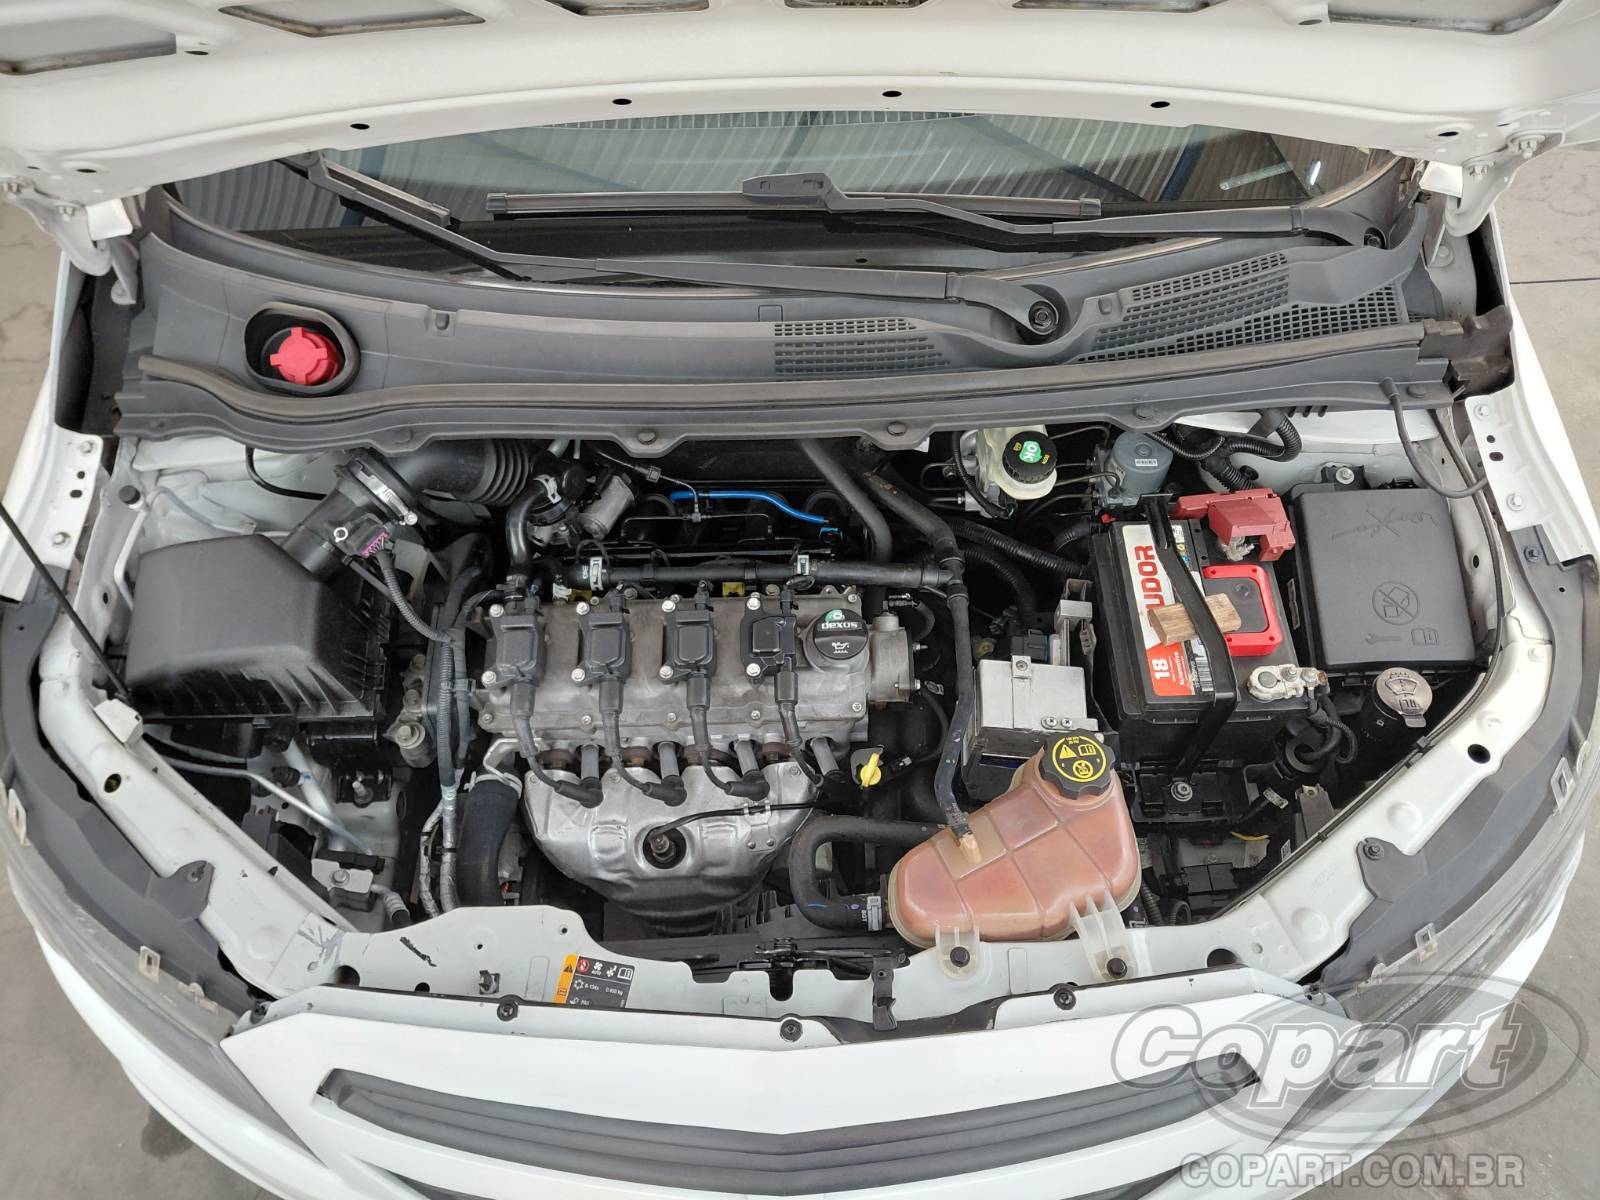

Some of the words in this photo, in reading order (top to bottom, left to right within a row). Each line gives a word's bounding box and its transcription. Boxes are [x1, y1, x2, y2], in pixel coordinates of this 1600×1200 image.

[1023, 445, 1038, 462] OK
[1134, 545, 1166, 616] UDOR
[821, 621, 858, 630] dexos
[1152, 658, 1170, 680] 18
[1173, 651, 1184, 686] Automotive
